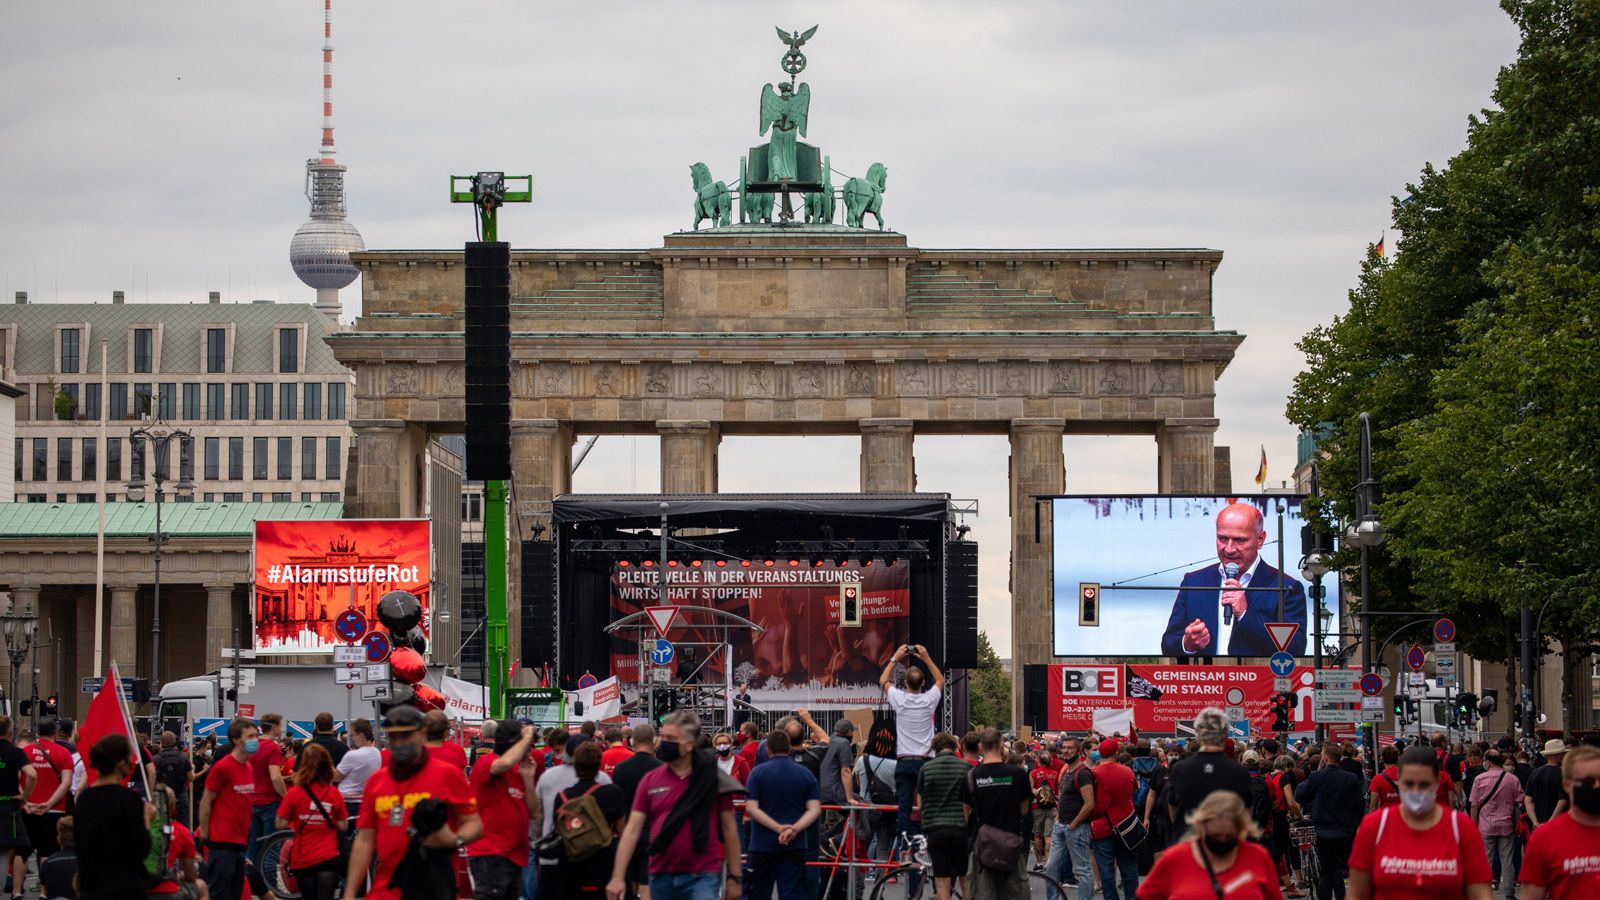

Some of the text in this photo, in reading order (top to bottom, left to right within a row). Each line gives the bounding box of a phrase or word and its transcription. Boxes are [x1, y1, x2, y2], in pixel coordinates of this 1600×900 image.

[267, 564, 419, 584] #AlarmstufeRot
[704, 570, 717, 583] IN
[721, 570, 744, 583] DER
[747, 570, 865, 583] VERANSTALTUNGS-
[619, 587, 763, 599] WIRTSHAFT STOPPEN!
[871, 604, 903, 615] bedroht.
[1065, 670, 1115, 693] BOE
[1153, 671, 1257, 682] GEMEINSAM SIND
[1153, 684, 1178, 694] WIR
[1181, 685, 1223, 694] STARK!
